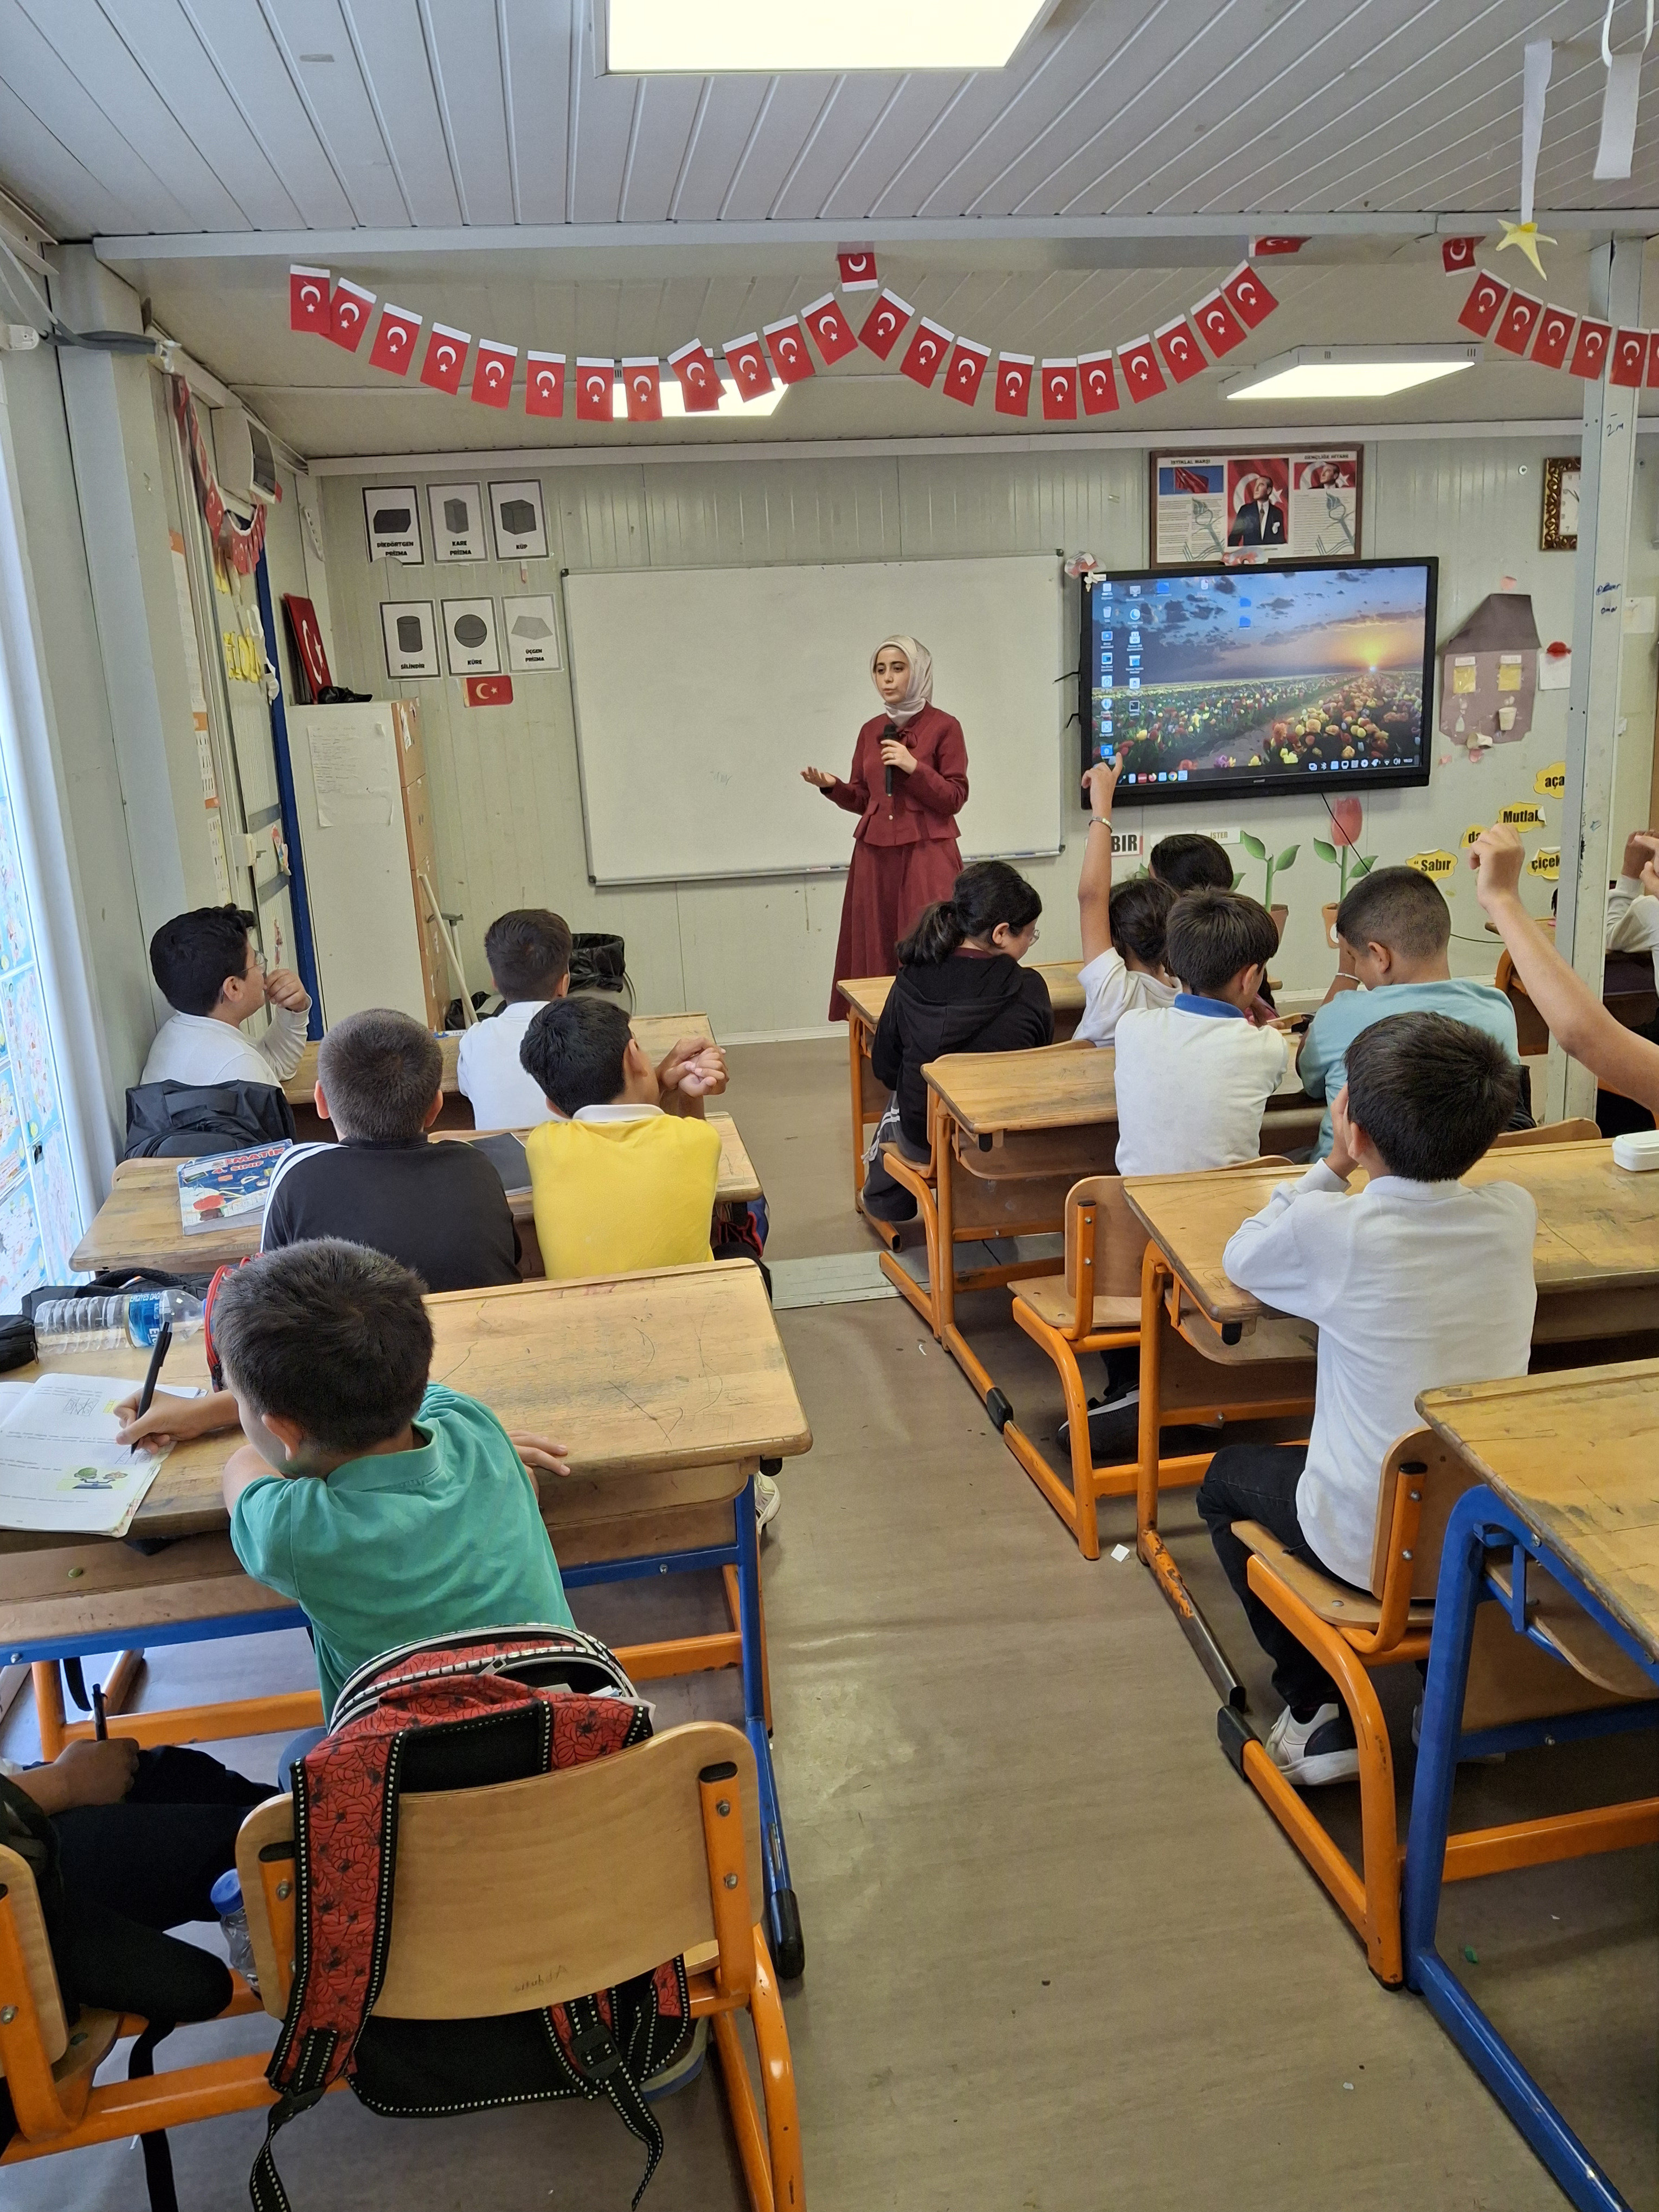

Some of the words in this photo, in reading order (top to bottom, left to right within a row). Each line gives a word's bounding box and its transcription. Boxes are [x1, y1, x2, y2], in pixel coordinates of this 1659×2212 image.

[1545, 776, 1565, 789] aça
[1111, 834, 1137, 852] BIR
[226, 1147, 286, 1165] EMATİK
